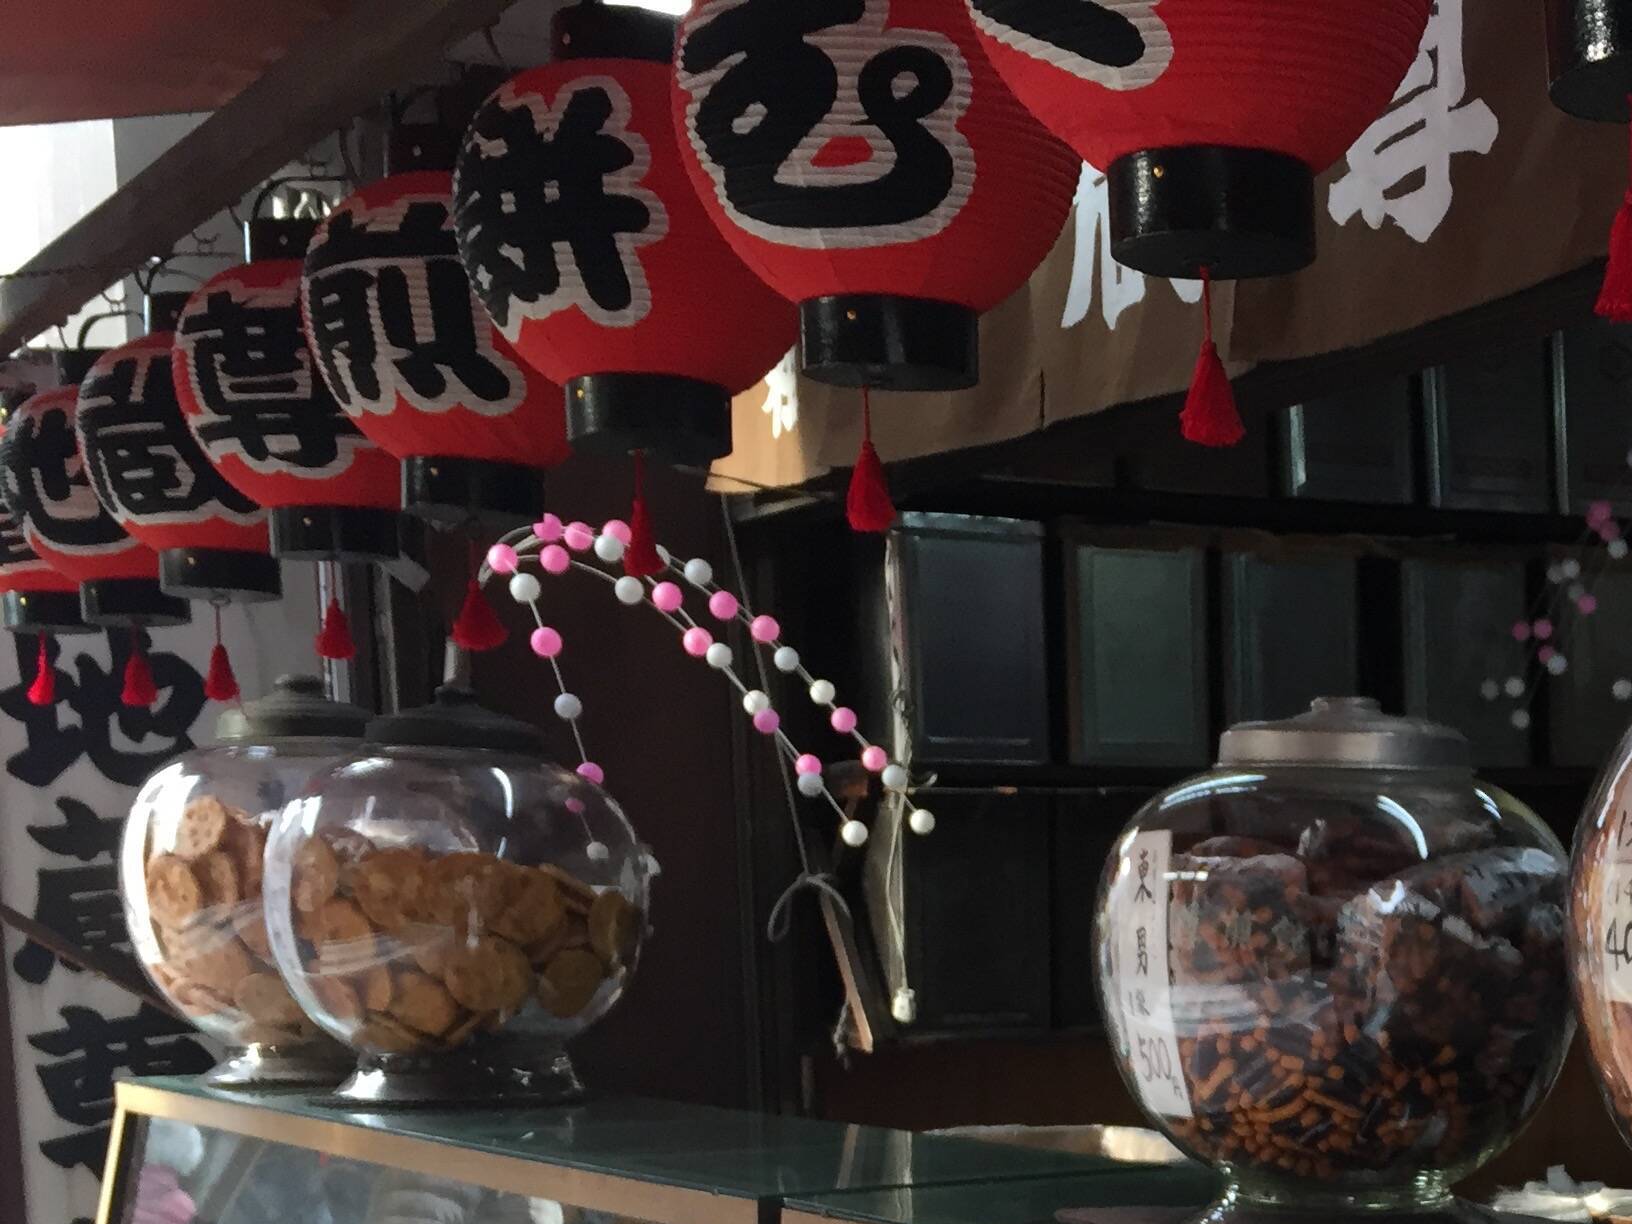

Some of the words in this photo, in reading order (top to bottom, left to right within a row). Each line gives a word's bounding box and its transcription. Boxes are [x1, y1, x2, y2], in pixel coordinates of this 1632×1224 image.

[303, 200, 512, 403] 煎
[455, 84, 652, 326] 餅
[182, 296, 375, 466] 尊
